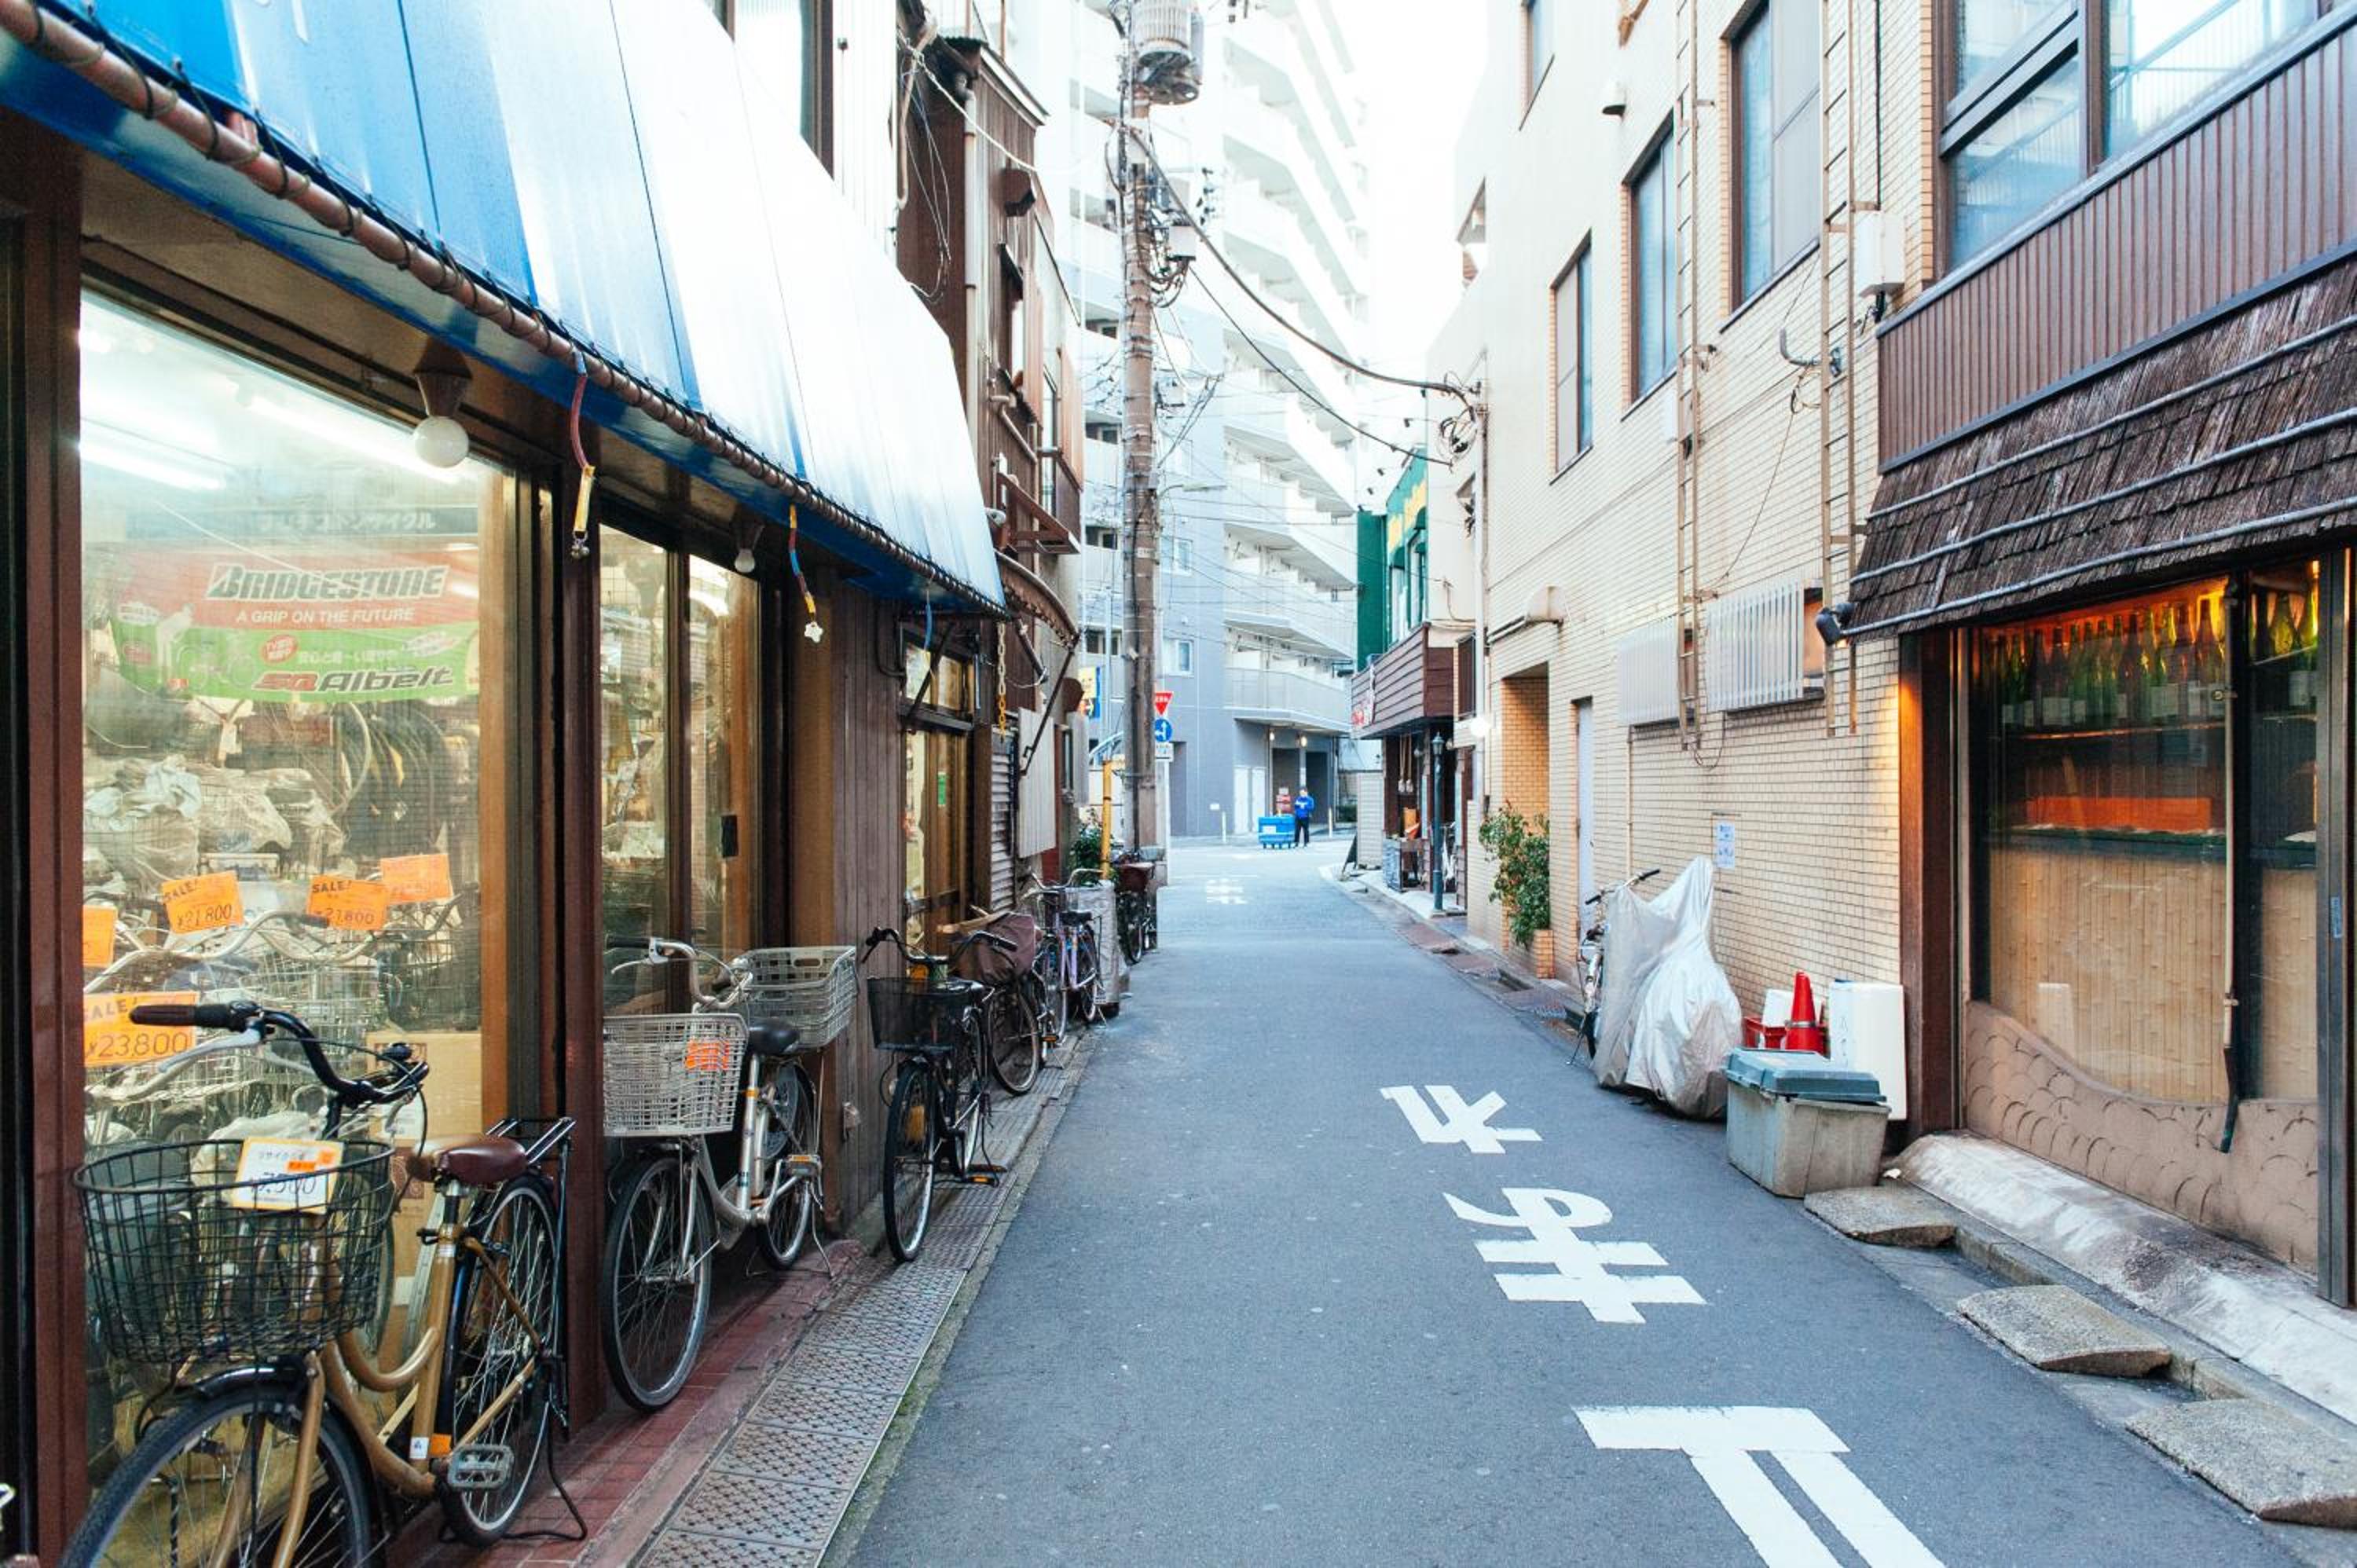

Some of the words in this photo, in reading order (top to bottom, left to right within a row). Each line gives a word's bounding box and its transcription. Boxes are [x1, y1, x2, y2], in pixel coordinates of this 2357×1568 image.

[206, 564, 449, 602] BRIDGESTONE
[236, 610, 247, 623] A
[251, 609, 288, 624] GRIP
[292, 609, 315, 623] ON
[320, 607, 351, 623] THE
[352, 606, 416, 622] FUTURE
[319, 666, 453, 693] Albelt
[84, 996, 137, 1020] ALE!
